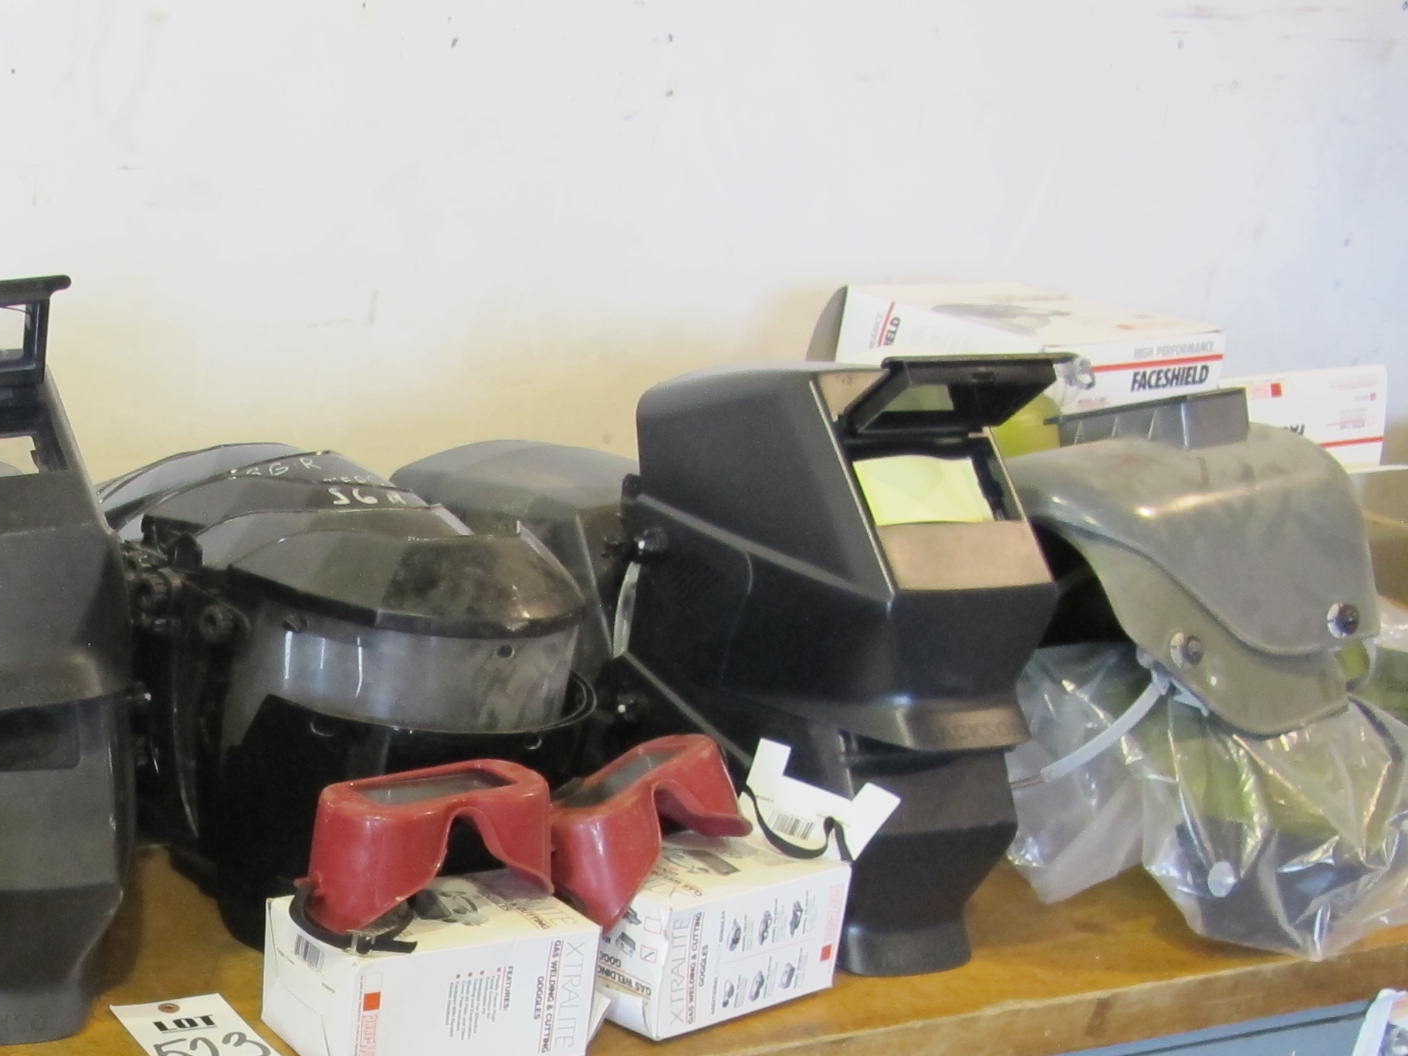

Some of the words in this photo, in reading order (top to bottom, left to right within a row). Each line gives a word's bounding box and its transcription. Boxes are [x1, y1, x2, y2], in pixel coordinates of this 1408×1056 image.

[1130, 364, 1210, 392] FACESHIELD
[693, 911, 703, 951] CUTTING
[547, 960, 558, 1003] WELDING
[670, 916, 690, 1025] XTRALITE
[698, 944, 709, 988] GOGGLES
[533, 975, 545, 1020] GOGGLES
[555, 941, 586, 1049] XTRALITE
[153, 1015, 217, 1033] LOT
[541, 1012, 553, 1054] CUTTING
